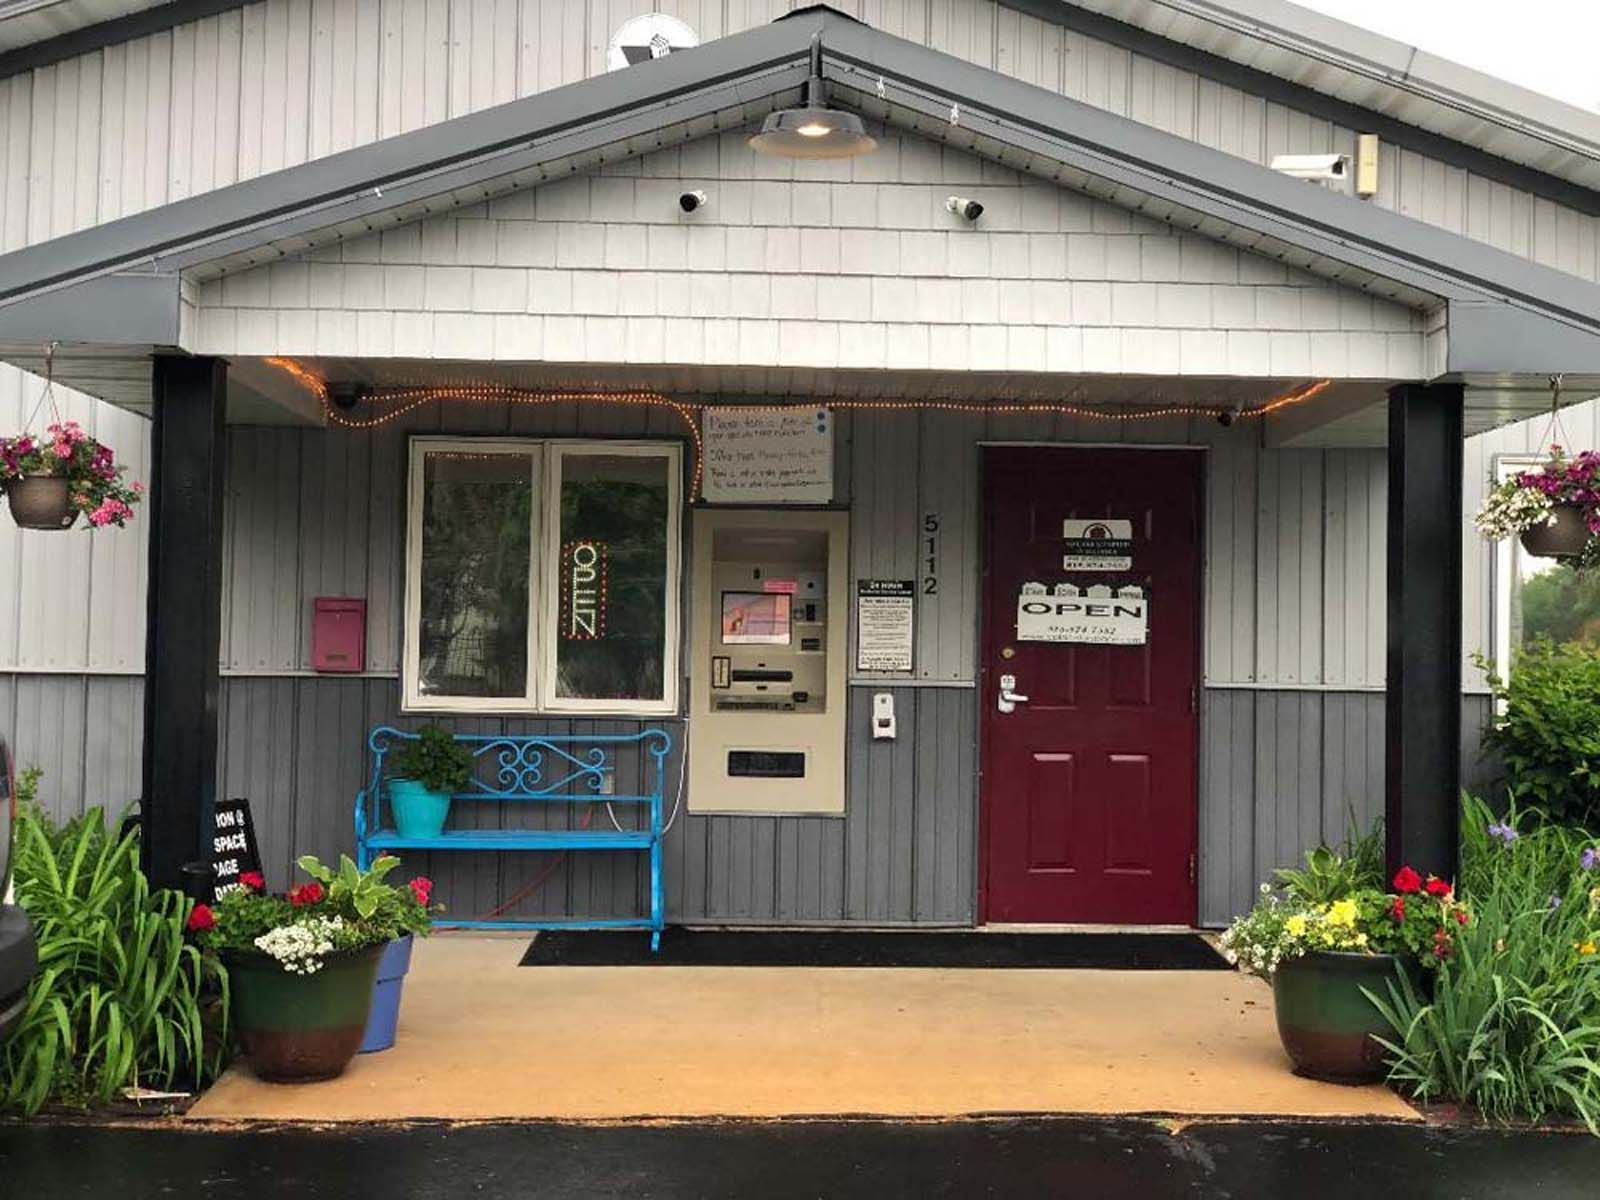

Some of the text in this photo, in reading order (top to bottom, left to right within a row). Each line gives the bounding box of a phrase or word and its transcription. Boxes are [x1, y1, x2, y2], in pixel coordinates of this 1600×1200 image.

[925, 514, 938, 594] 5112
[573, 545, 597, 636] OPEN
[1022, 602, 1141, 618] OPEN
[214, 831, 247, 852] SPACE
